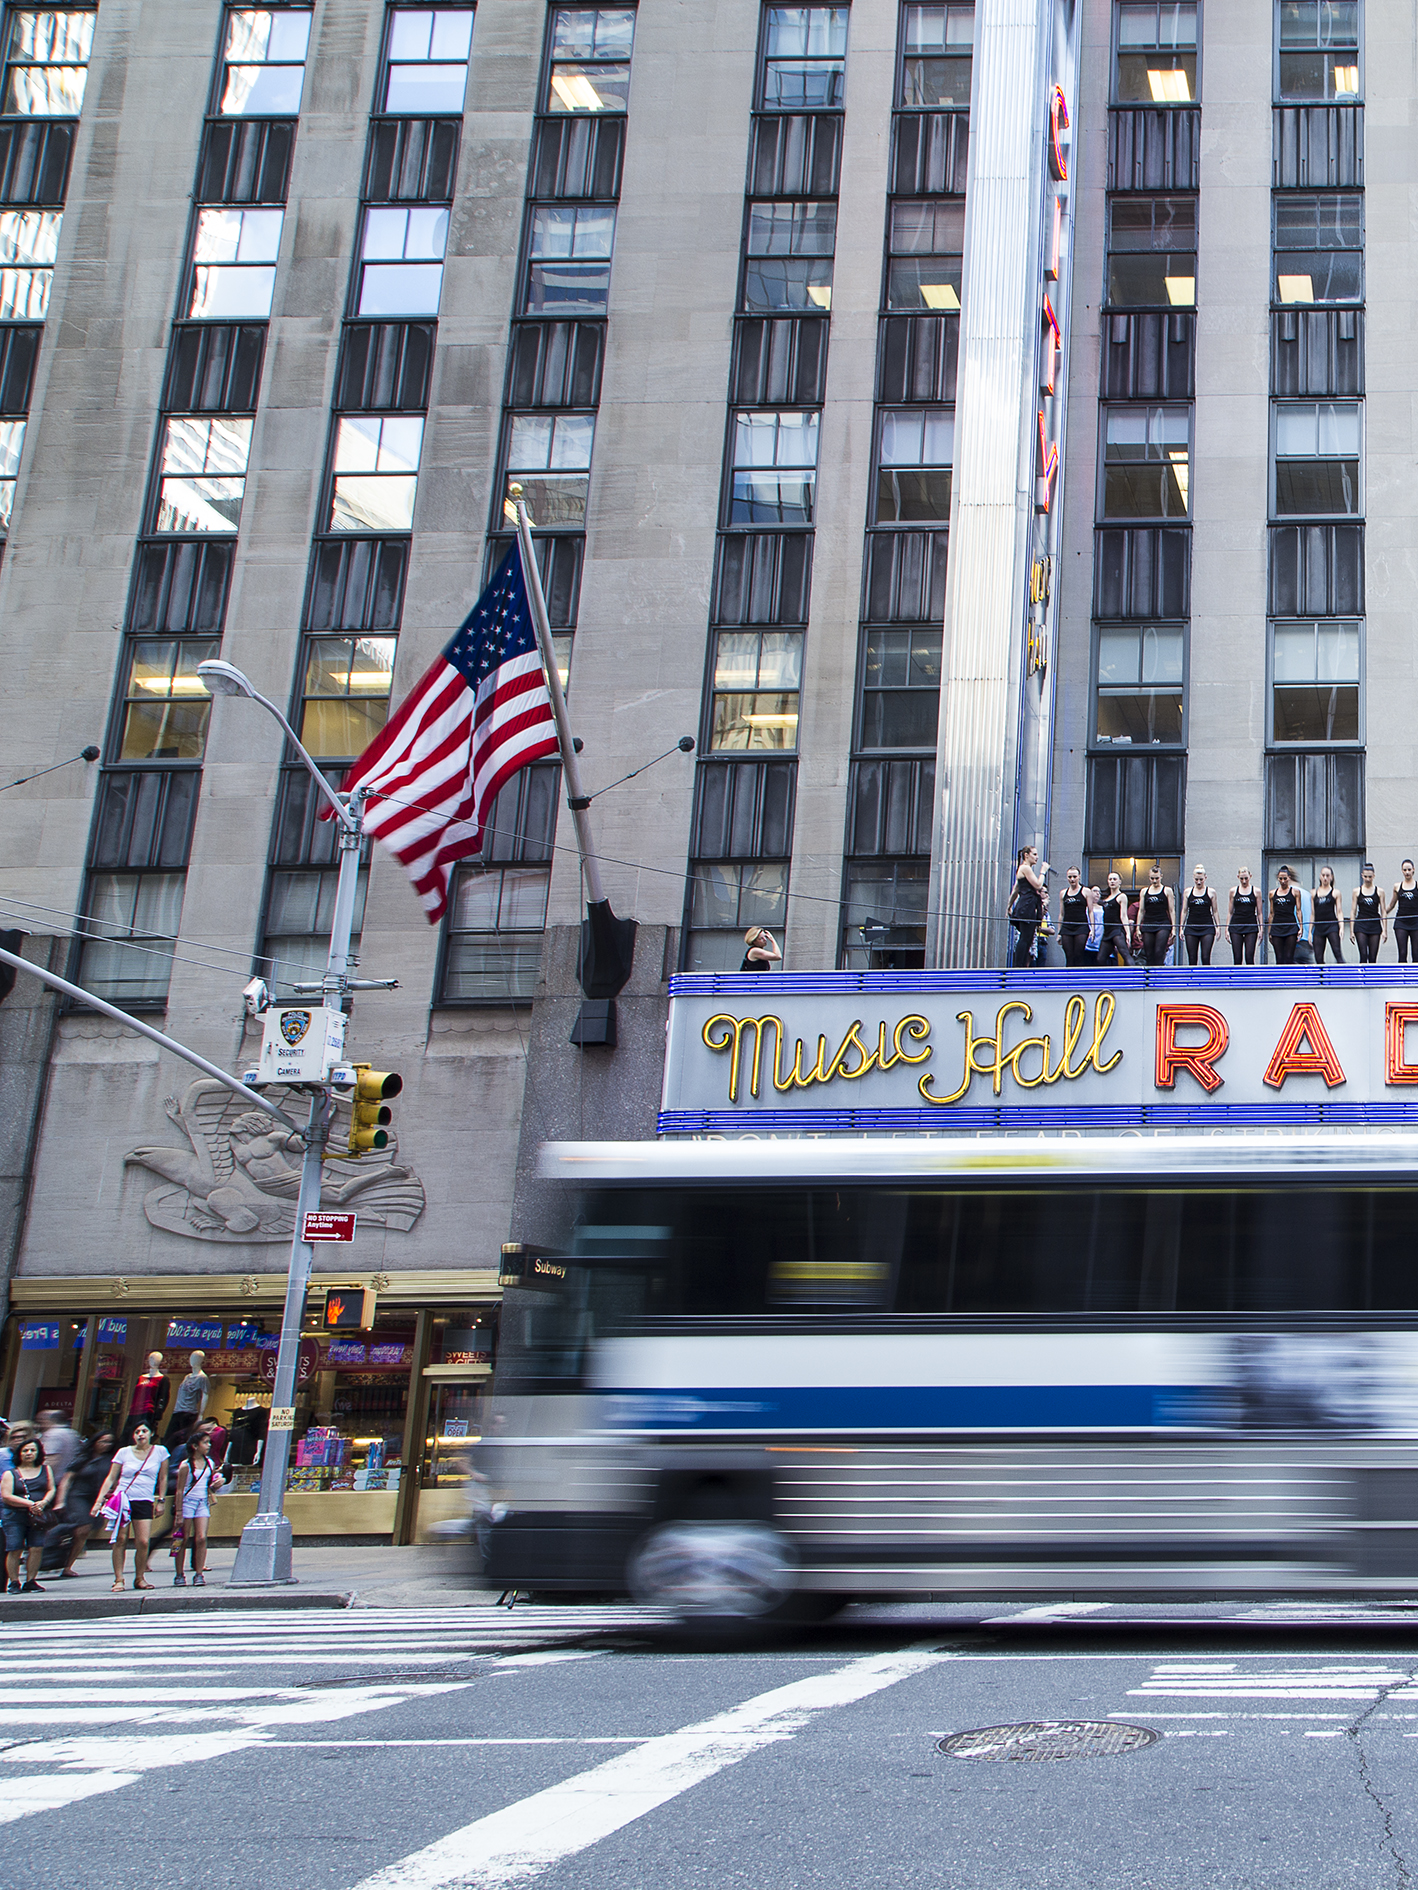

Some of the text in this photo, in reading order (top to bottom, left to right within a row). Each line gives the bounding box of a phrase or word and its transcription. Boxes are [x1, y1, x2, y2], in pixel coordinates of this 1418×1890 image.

[702, 1012, 931, 1103] Music
[917, 989, 1123, 1105] Hall
[307, 1221, 333, 1229] Anytime
[535, 1258, 567, 1279] Subway
